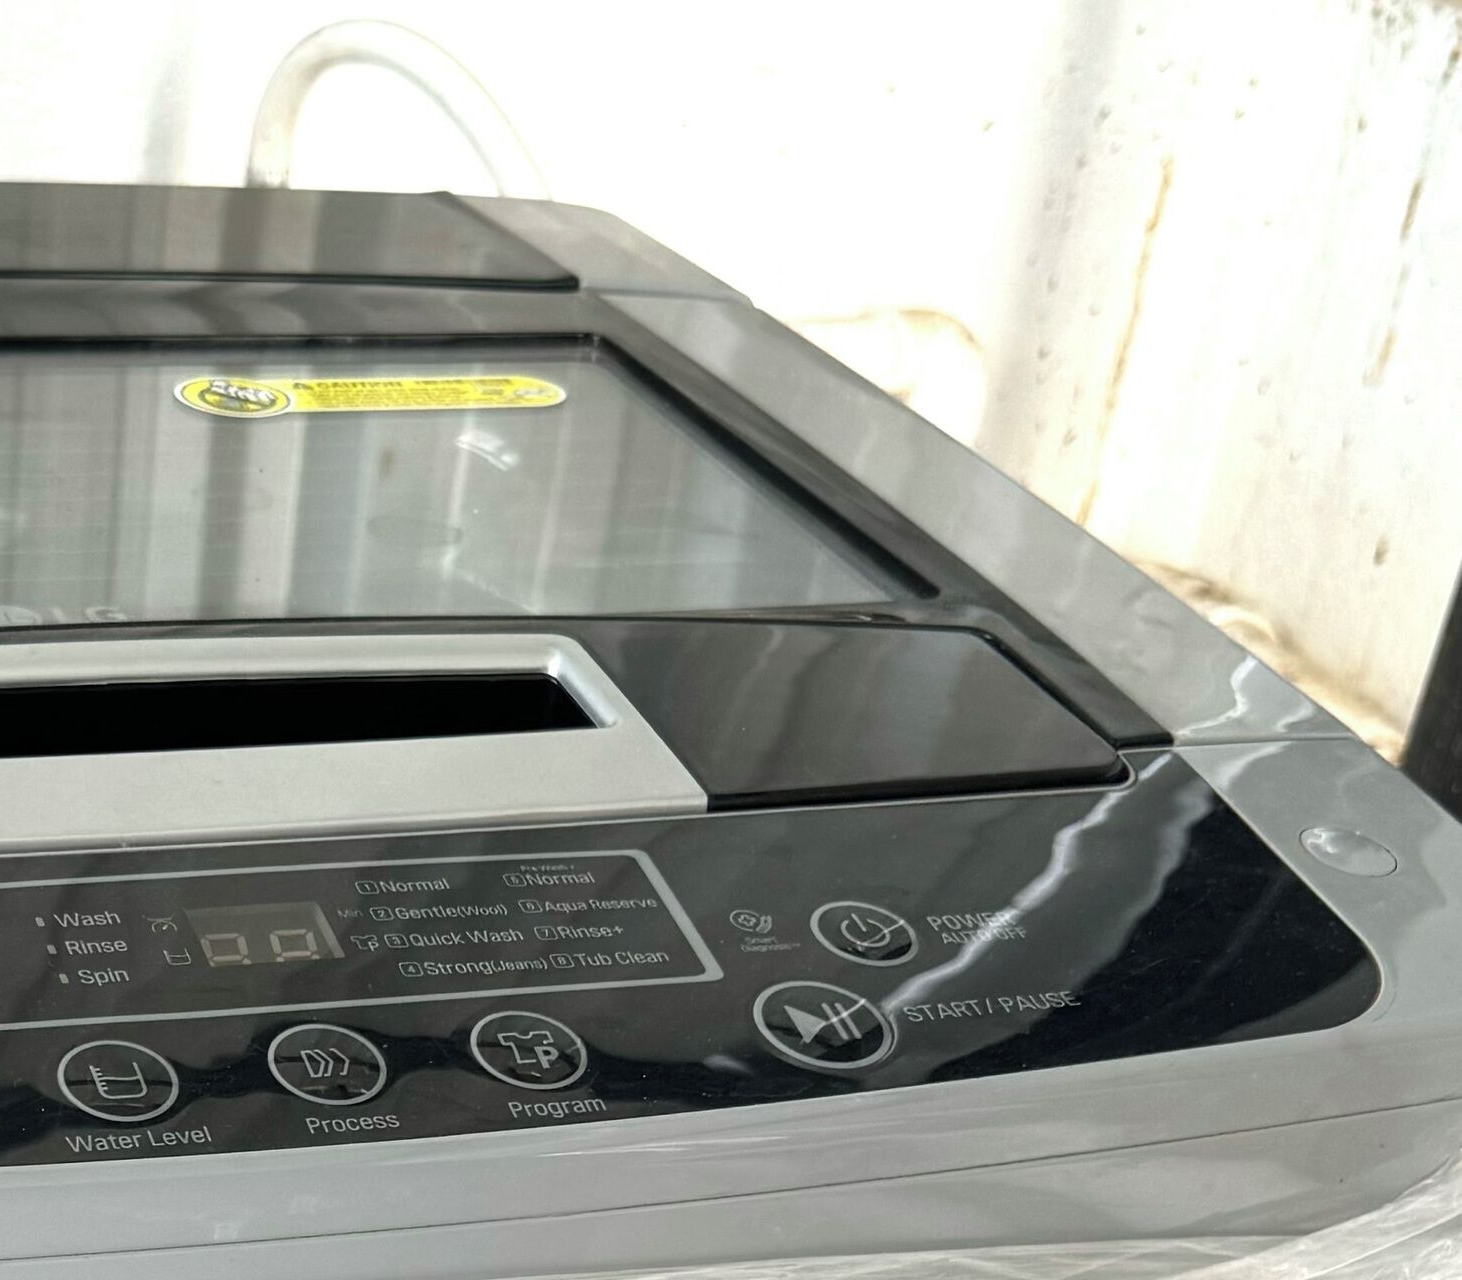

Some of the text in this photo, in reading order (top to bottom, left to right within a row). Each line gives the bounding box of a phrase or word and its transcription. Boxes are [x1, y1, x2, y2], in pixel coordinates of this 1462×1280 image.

[379, 878, 451, 894] Normal
[525, 871, 596, 887] Normal
[394, 904, 509, 921] Gentle(Wool)
[544, 900, 588, 914] Aqua
[588, 898, 658, 911] Reserve
[53, 910, 122, 930] Wash
[925, 911, 1017, 932] POWER
[409, 931, 466, 948] Quick
[466, 928, 525, 944] Wash
[556, 925, 624, 940] Rinse+
[64, 937, 129, 956] Rinse
[423, 958, 549, 976] Strong(Jeans)
[573, 951, 613, 968] Tub
[615, 950, 670, 965] Clean
[77, 966, 130, 988] Spin
[902, 1002, 983, 1024] START
[997, 990, 1082, 1013] PAUSE
[507, 1096, 607, 1120] Program
[305, 1112, 401, 1135] Process
[66, 1125, 213, 1154] Water Level
